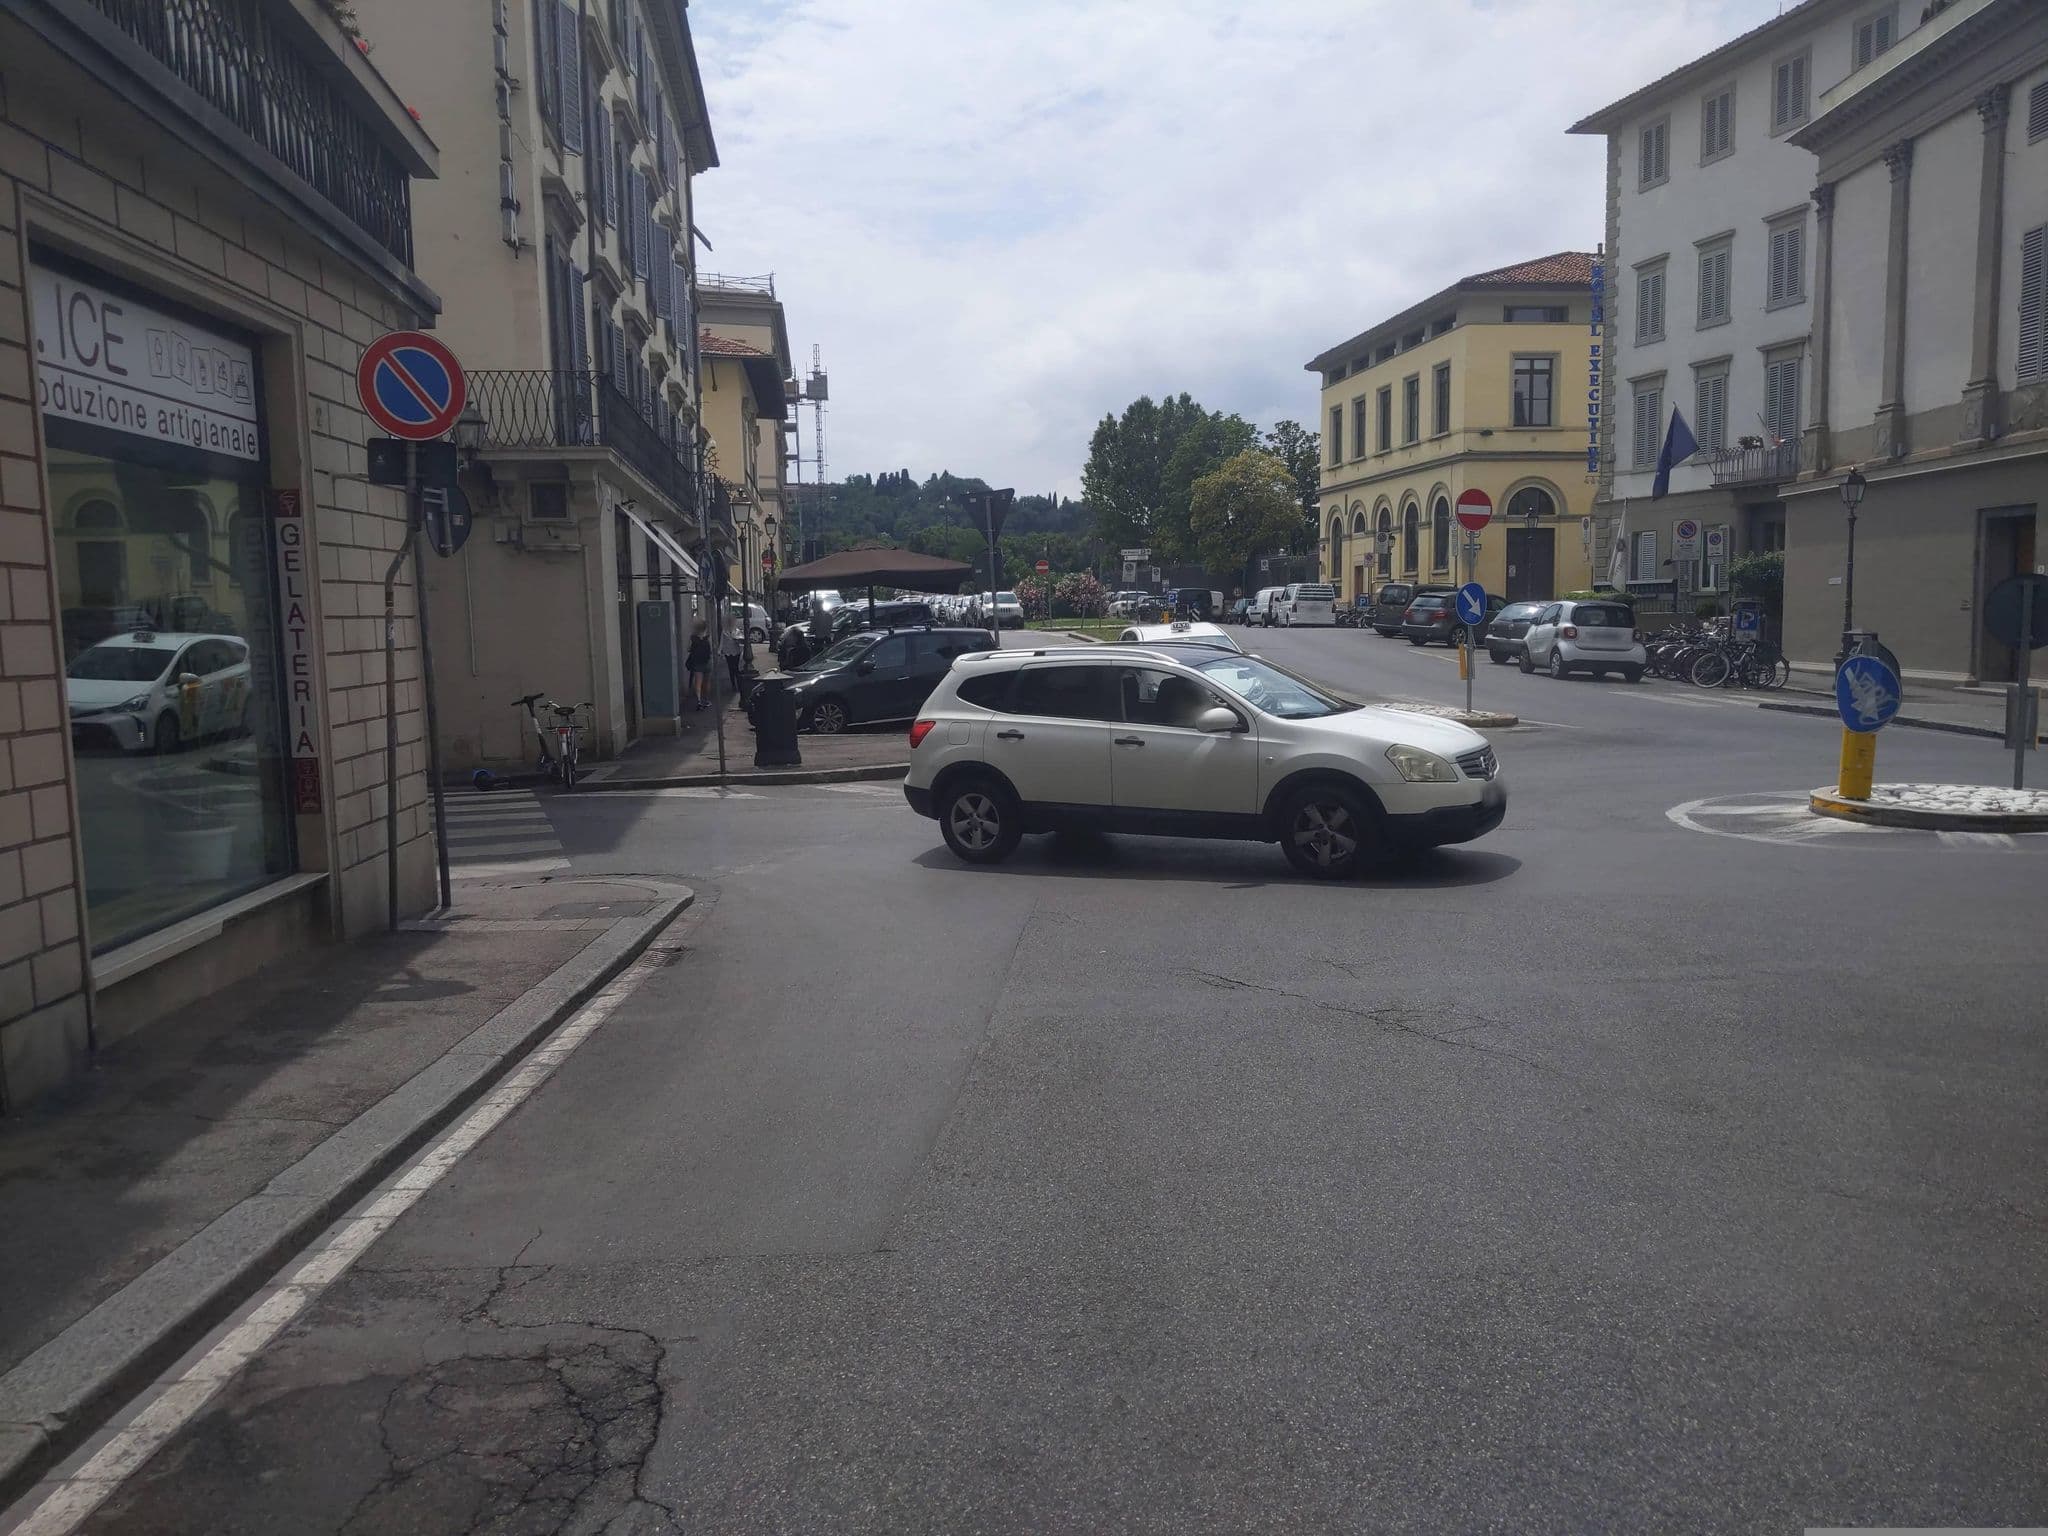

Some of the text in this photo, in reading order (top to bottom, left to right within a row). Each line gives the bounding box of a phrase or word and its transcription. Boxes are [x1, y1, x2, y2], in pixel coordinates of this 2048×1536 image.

[158, 408, 256, 455] artigianale
[1587, 344, 1600, 473] EXECUTIVE
[280, 523, 314, 753] GELATERIA
